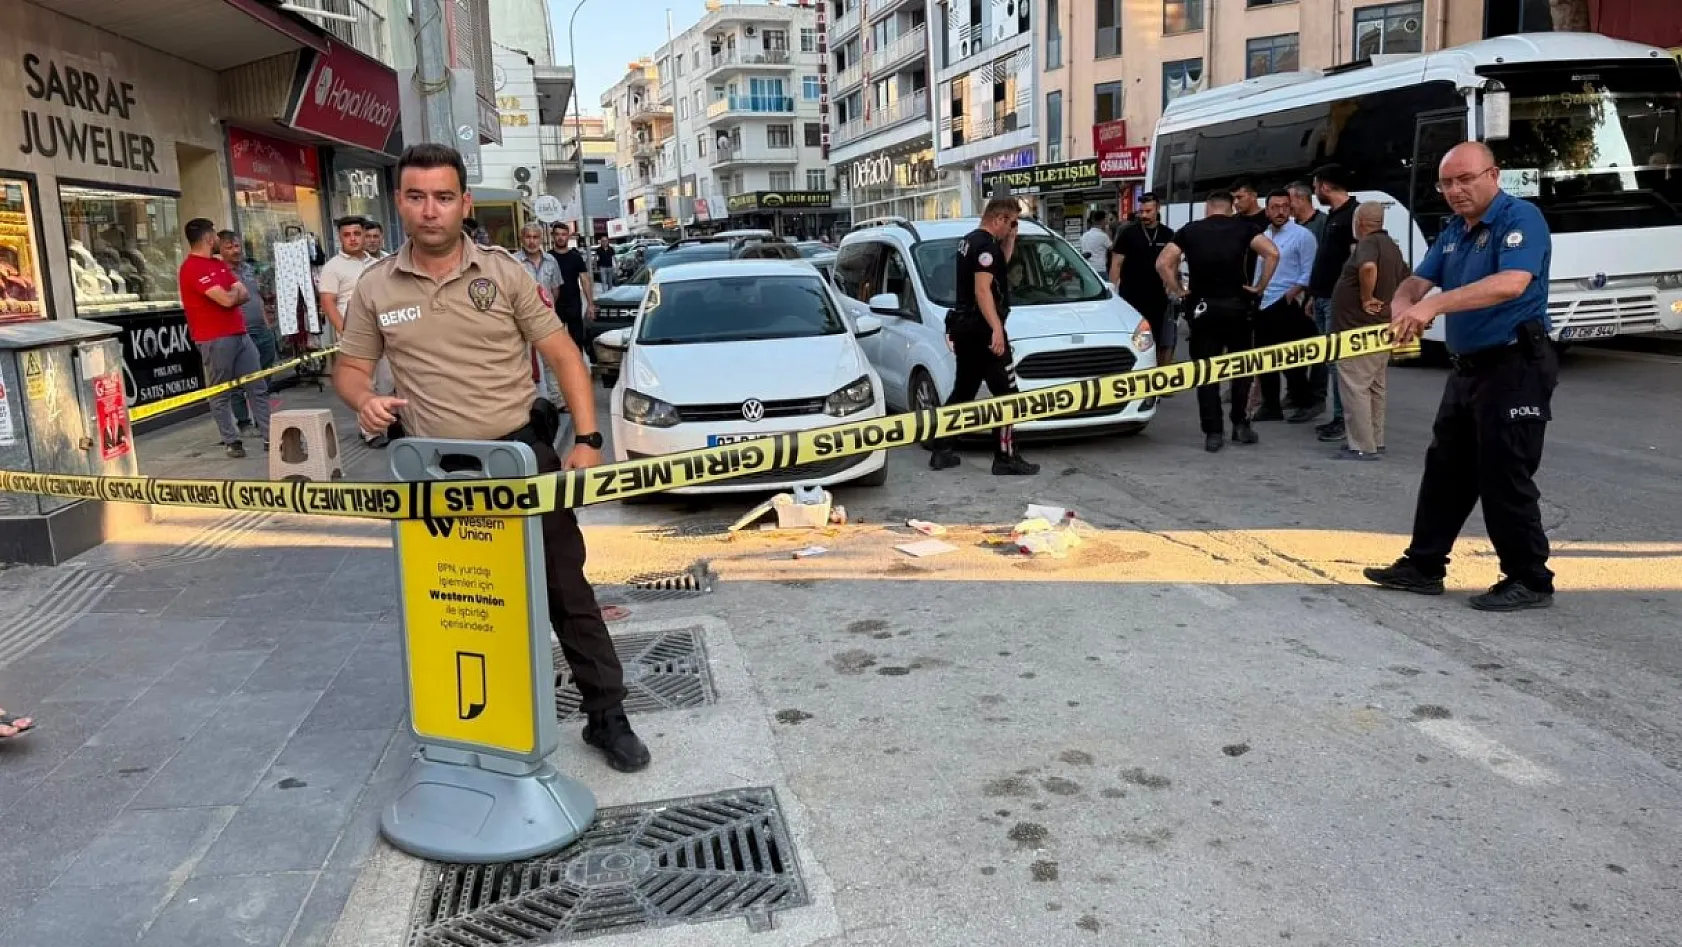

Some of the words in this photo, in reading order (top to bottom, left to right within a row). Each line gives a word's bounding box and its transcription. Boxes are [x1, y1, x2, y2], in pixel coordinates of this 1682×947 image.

[23, 53, 136, 120] SARRAF
[20, 110, 159, 174] JUWELIER
[379, 305, 421, 327] BEKÇİ
[130, 323, 192, 359] KOÇAK
[1351, 328, 1395, 352] OLİS
[1217, 340, 1320, 378] GİRİLMEZ
[1112, 366, 1186, 399] POLİS
[943, 390, 1074, 430] GİRİLMEZ
[814, 420, 905, 455] POLİS
[593, 445, 765, 496] GİRİLMEZ
[242, 485, 287, 507] POLİS
[306, 487, 400, 513] GİRİLMEZ
[444, 483, 541, 511] POLİS
[458, 515, 505, 530] Western
[458, 527, 493, 542] Union
[429, 589, 474, 603] Western
[475, 594, 505, 606] Union
